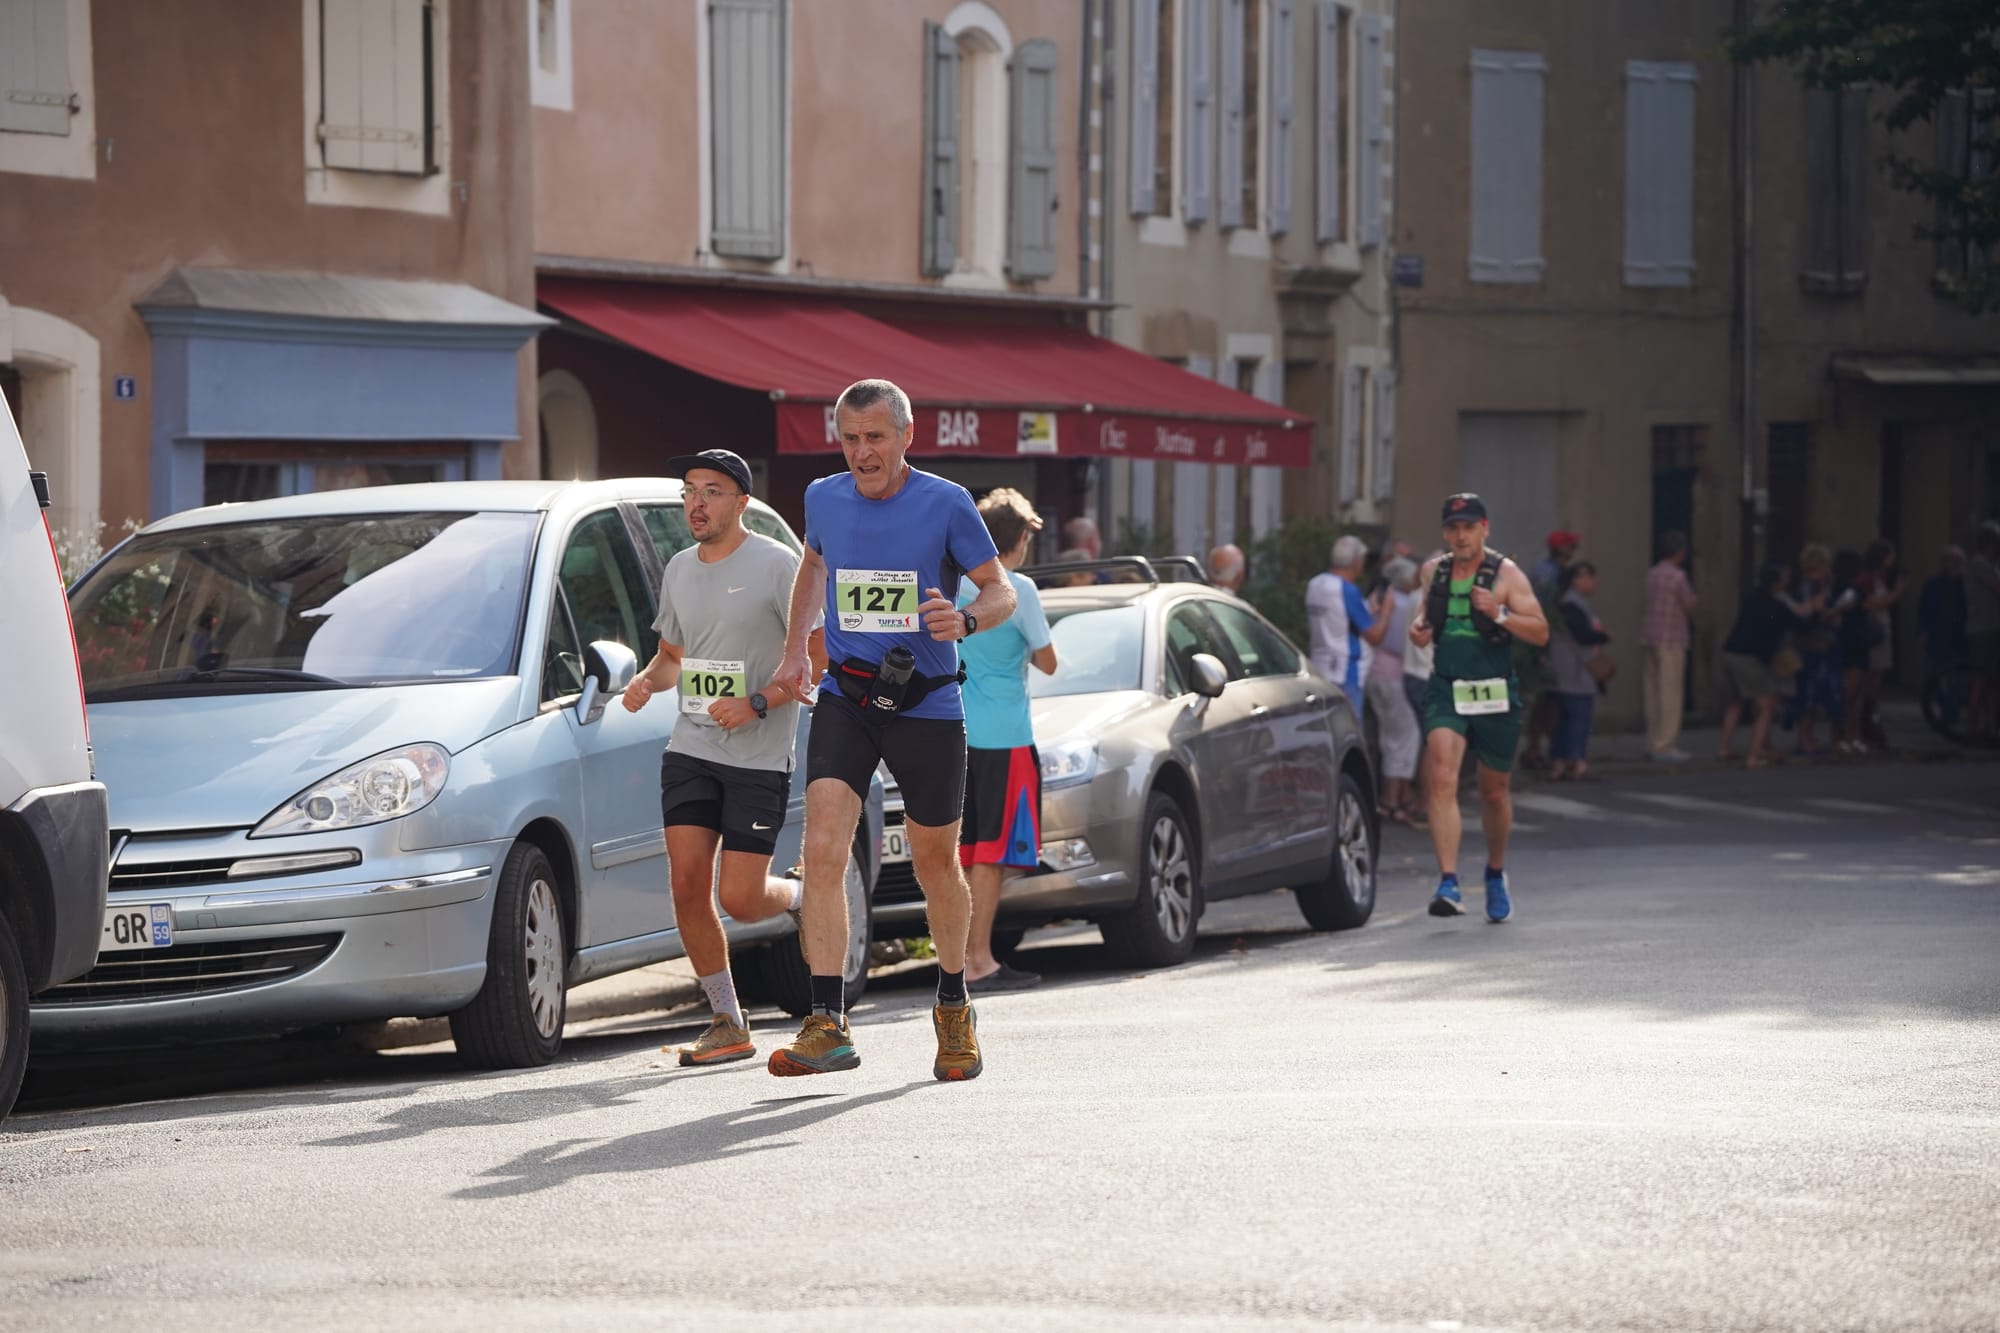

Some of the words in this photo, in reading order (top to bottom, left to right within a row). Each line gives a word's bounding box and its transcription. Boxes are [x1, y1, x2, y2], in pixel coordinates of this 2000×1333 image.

[936, 410, 980, 447] BAR
[847, 586, 906, 612] 127
[691, 673, 736, 697] 102
[1468, 686, 1491, 701] 11
[153, 925, 170, 941] 59
